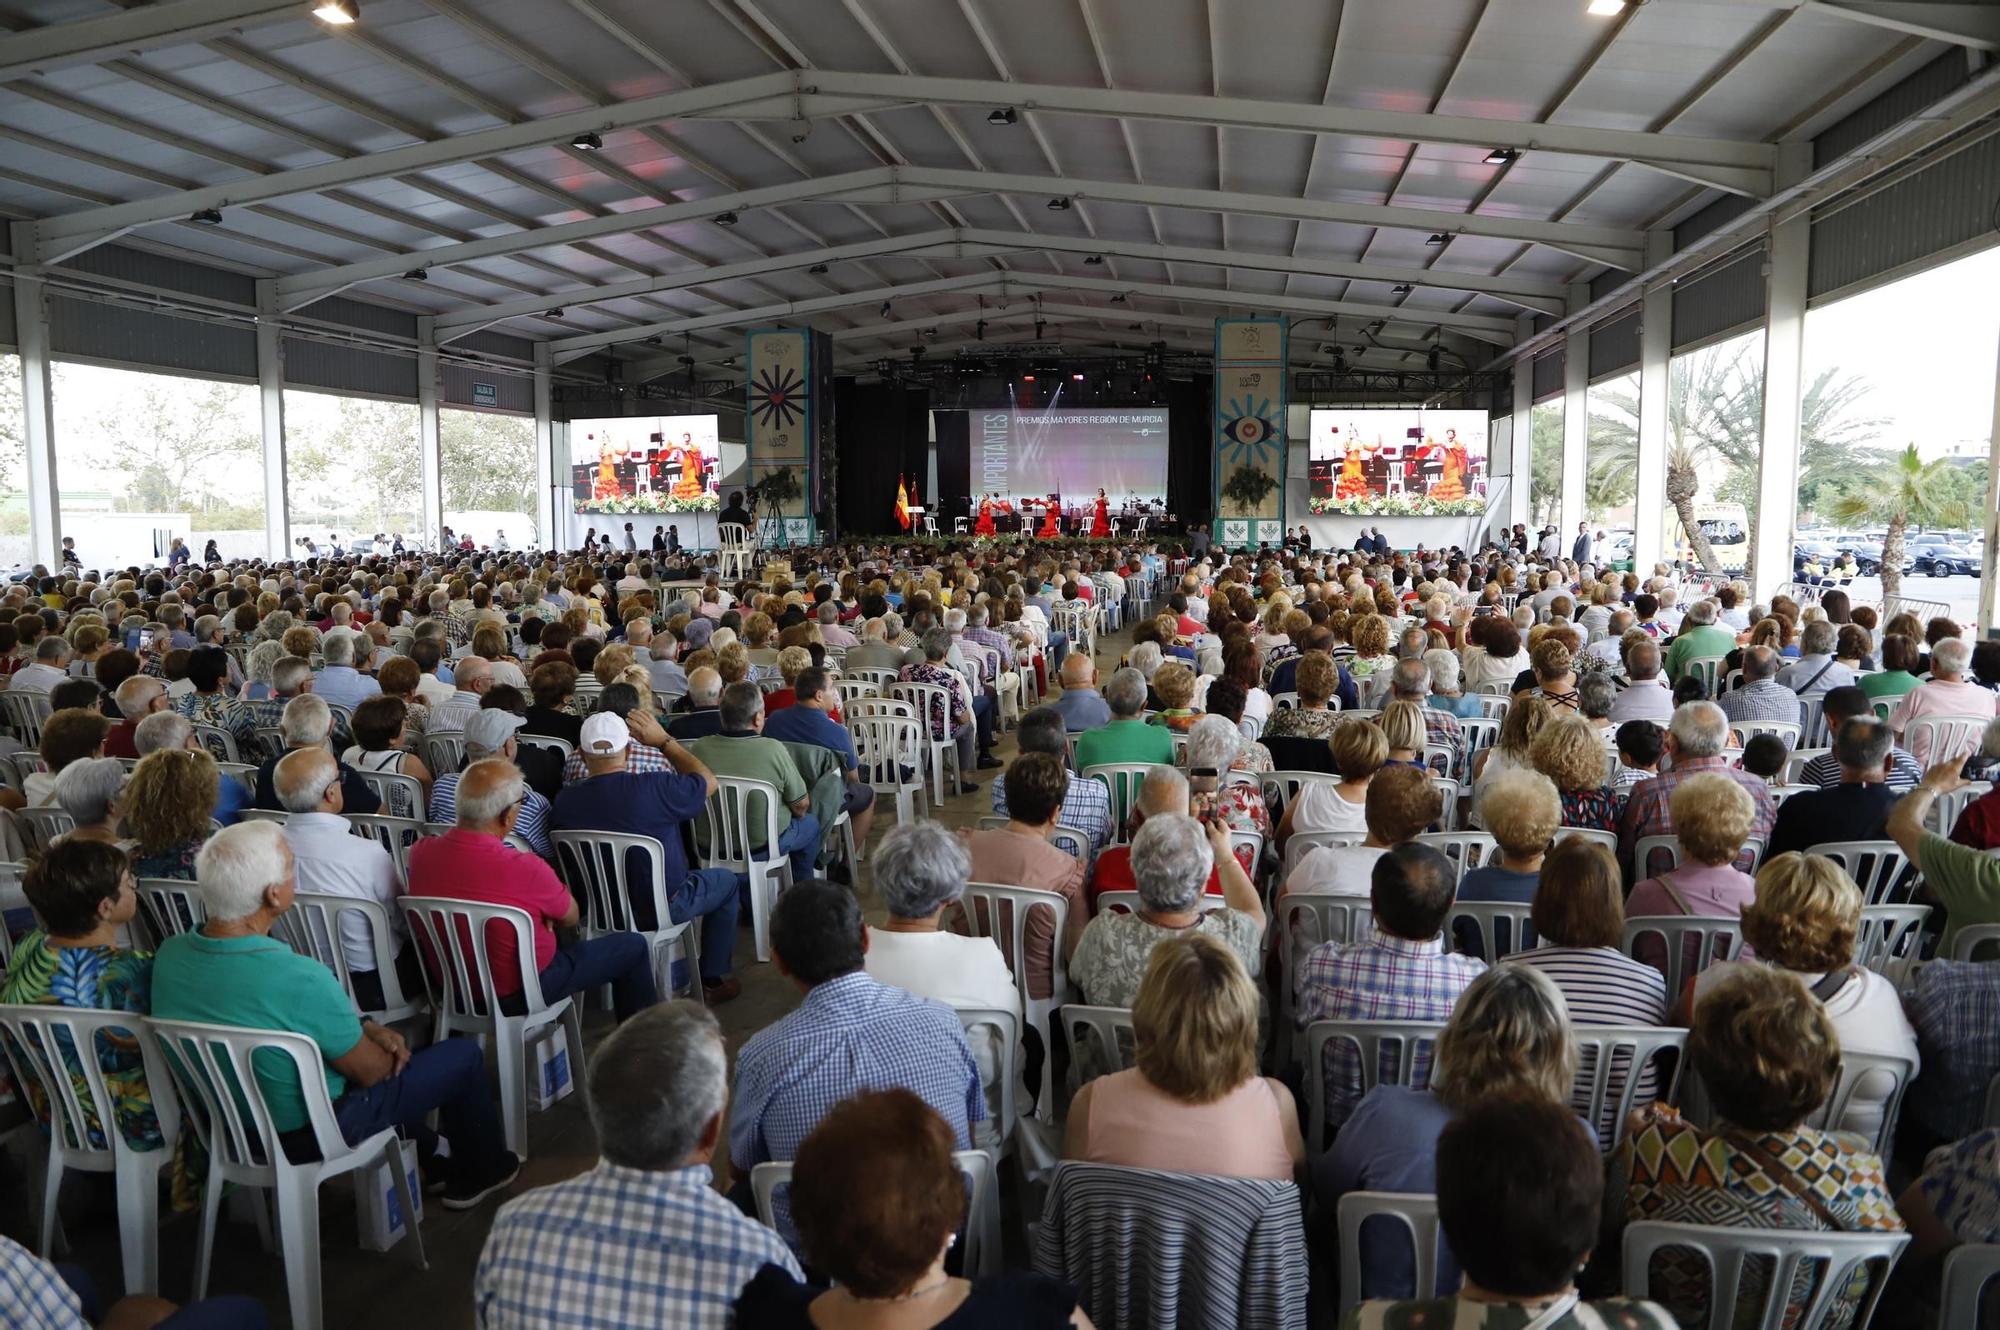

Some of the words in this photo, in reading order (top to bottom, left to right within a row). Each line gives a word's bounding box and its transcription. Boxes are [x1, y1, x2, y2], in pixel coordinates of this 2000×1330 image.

[1016, 416, 1049, 424] PREMIOS
[1050, 415, 1088, 424] MAYORES
[1089, 414, 1118, 424] REGIÓN
[1120, 415, 1130, 424] DE
[1132, 415, 1163, 423] MURCIA
[983, 414, 1008, 492] IMPORTANTES
